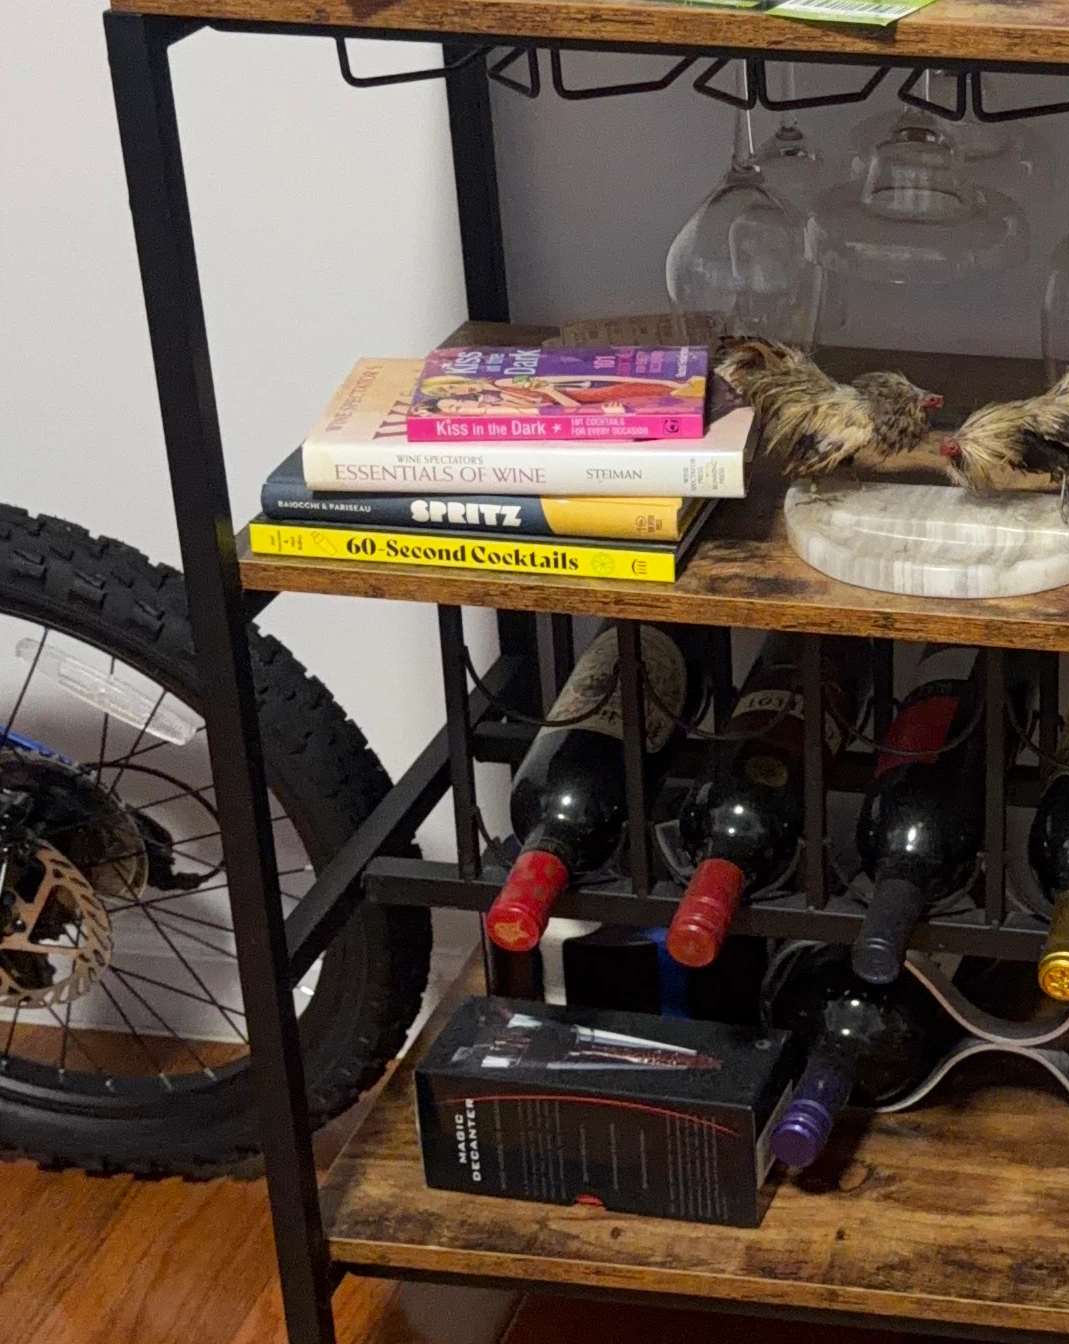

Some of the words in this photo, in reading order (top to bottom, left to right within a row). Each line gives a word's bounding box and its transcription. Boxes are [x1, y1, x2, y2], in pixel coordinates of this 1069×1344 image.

[445, 351, 483, 373] Kiss
[503, 349, 541, 375] Dark
[436, 418, 469, 436] Kiss
[472, 423, 484, 435] in
[487, 422, 507, 435] the
[511, 419, 546, 436] Dark
[397, 455, 422, 464] WINE
[424, 455, 483, 465] SPECTATOR'S
[335, 463, 454, 482] ESSENTIALS
[460, 466, 487, 483] OF
[492, 467, 546, 484] WINE
[586, 468, 642, 480] STEIMAN
[277, 500, 320, 510] BAIOCCHI
[322, 502, 327, 510] &
[329, 503, 372, 513] PARISEAU
[410, 499, 522, 527] SPRITZ
[346, 536, 466, 562] 60-Second
[471, 545, 579, 571] Cocktails
[454, 1113, 467, 1164] MAGIC
[465, 1098, 482, 1181] DECANTER
